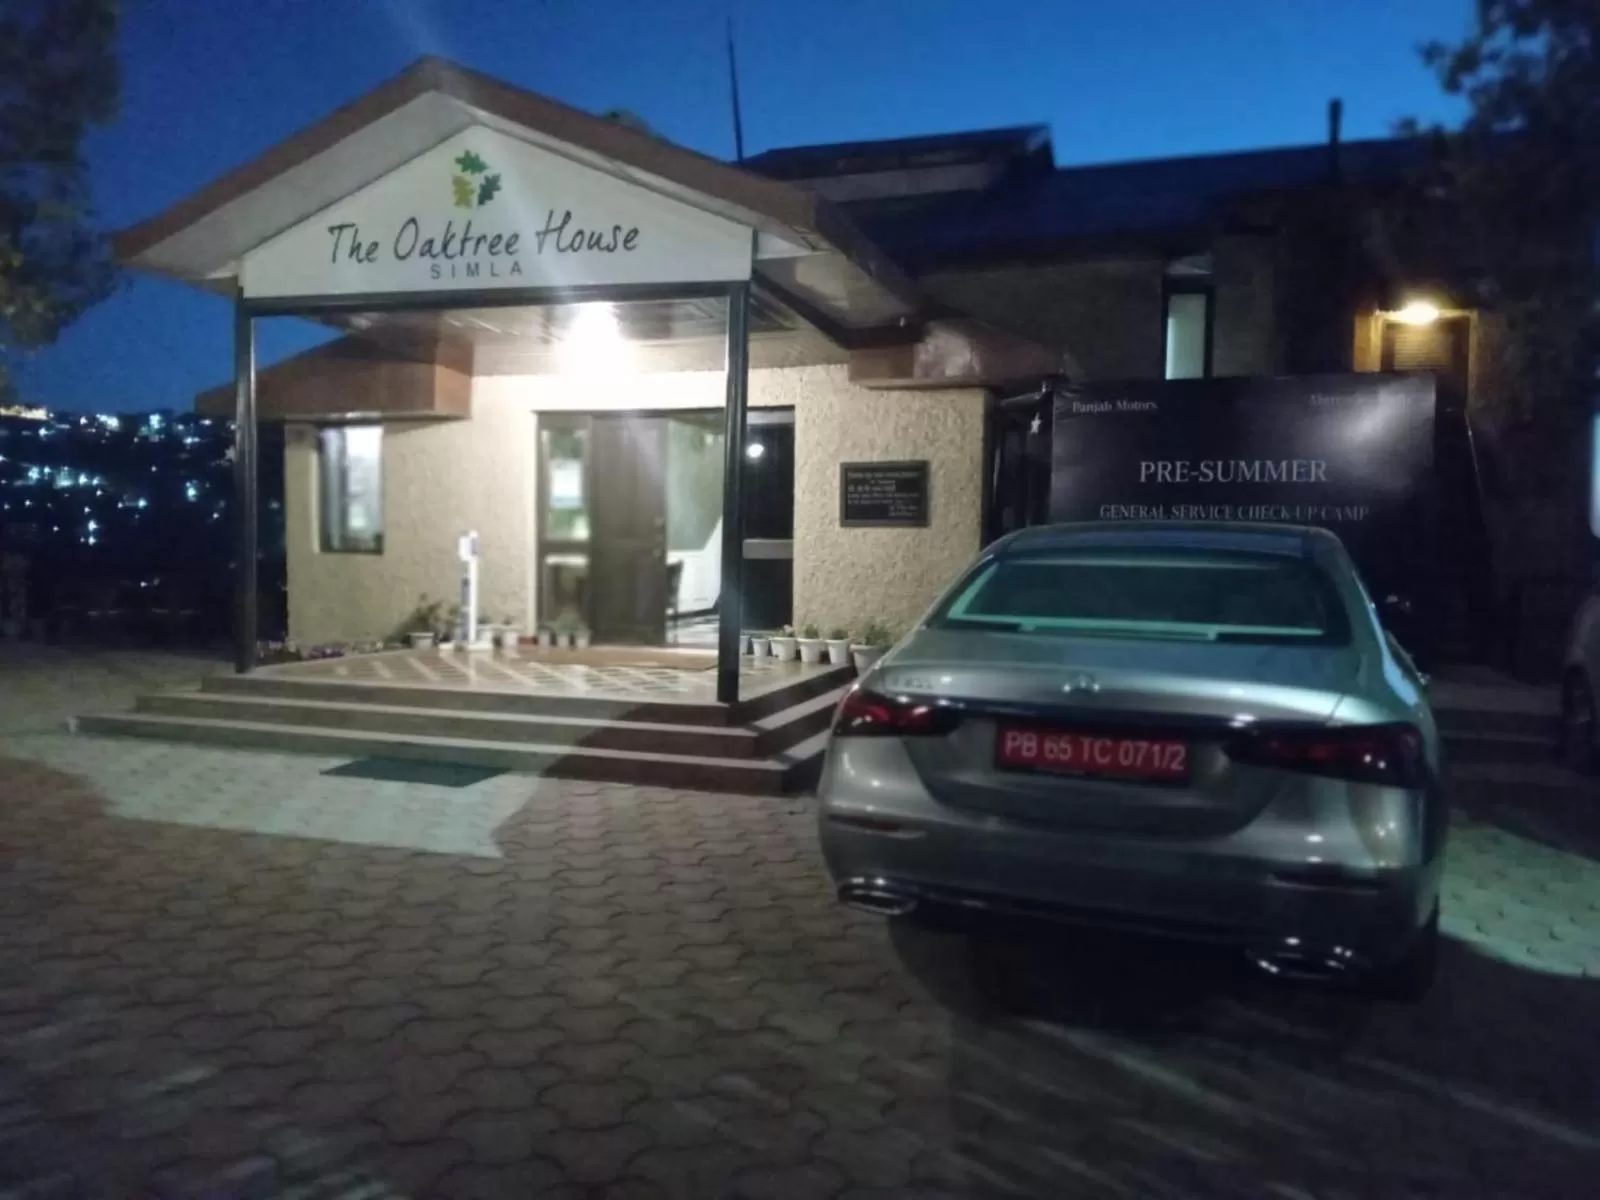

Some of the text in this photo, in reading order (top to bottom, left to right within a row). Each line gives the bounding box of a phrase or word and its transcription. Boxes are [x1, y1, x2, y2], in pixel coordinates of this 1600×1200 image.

[327, 209, 640, 264] The Oaktree House
[430, 261, 523, 280] SIMLA
[1115, 399, 1158, 412] Motors
[1139, 459, 1328, 483] PRE-SUMMER
[1099, 504, 1165, 519] GENERAL
[1171, 504, 1234, 520] SERVICE
[1320, 505, 1370, 521] CAMP
[1005, 731, 1037, 757] PB
[1043, 735, 1072, 761] 65
[1078, 736, 1113, 764] TC
